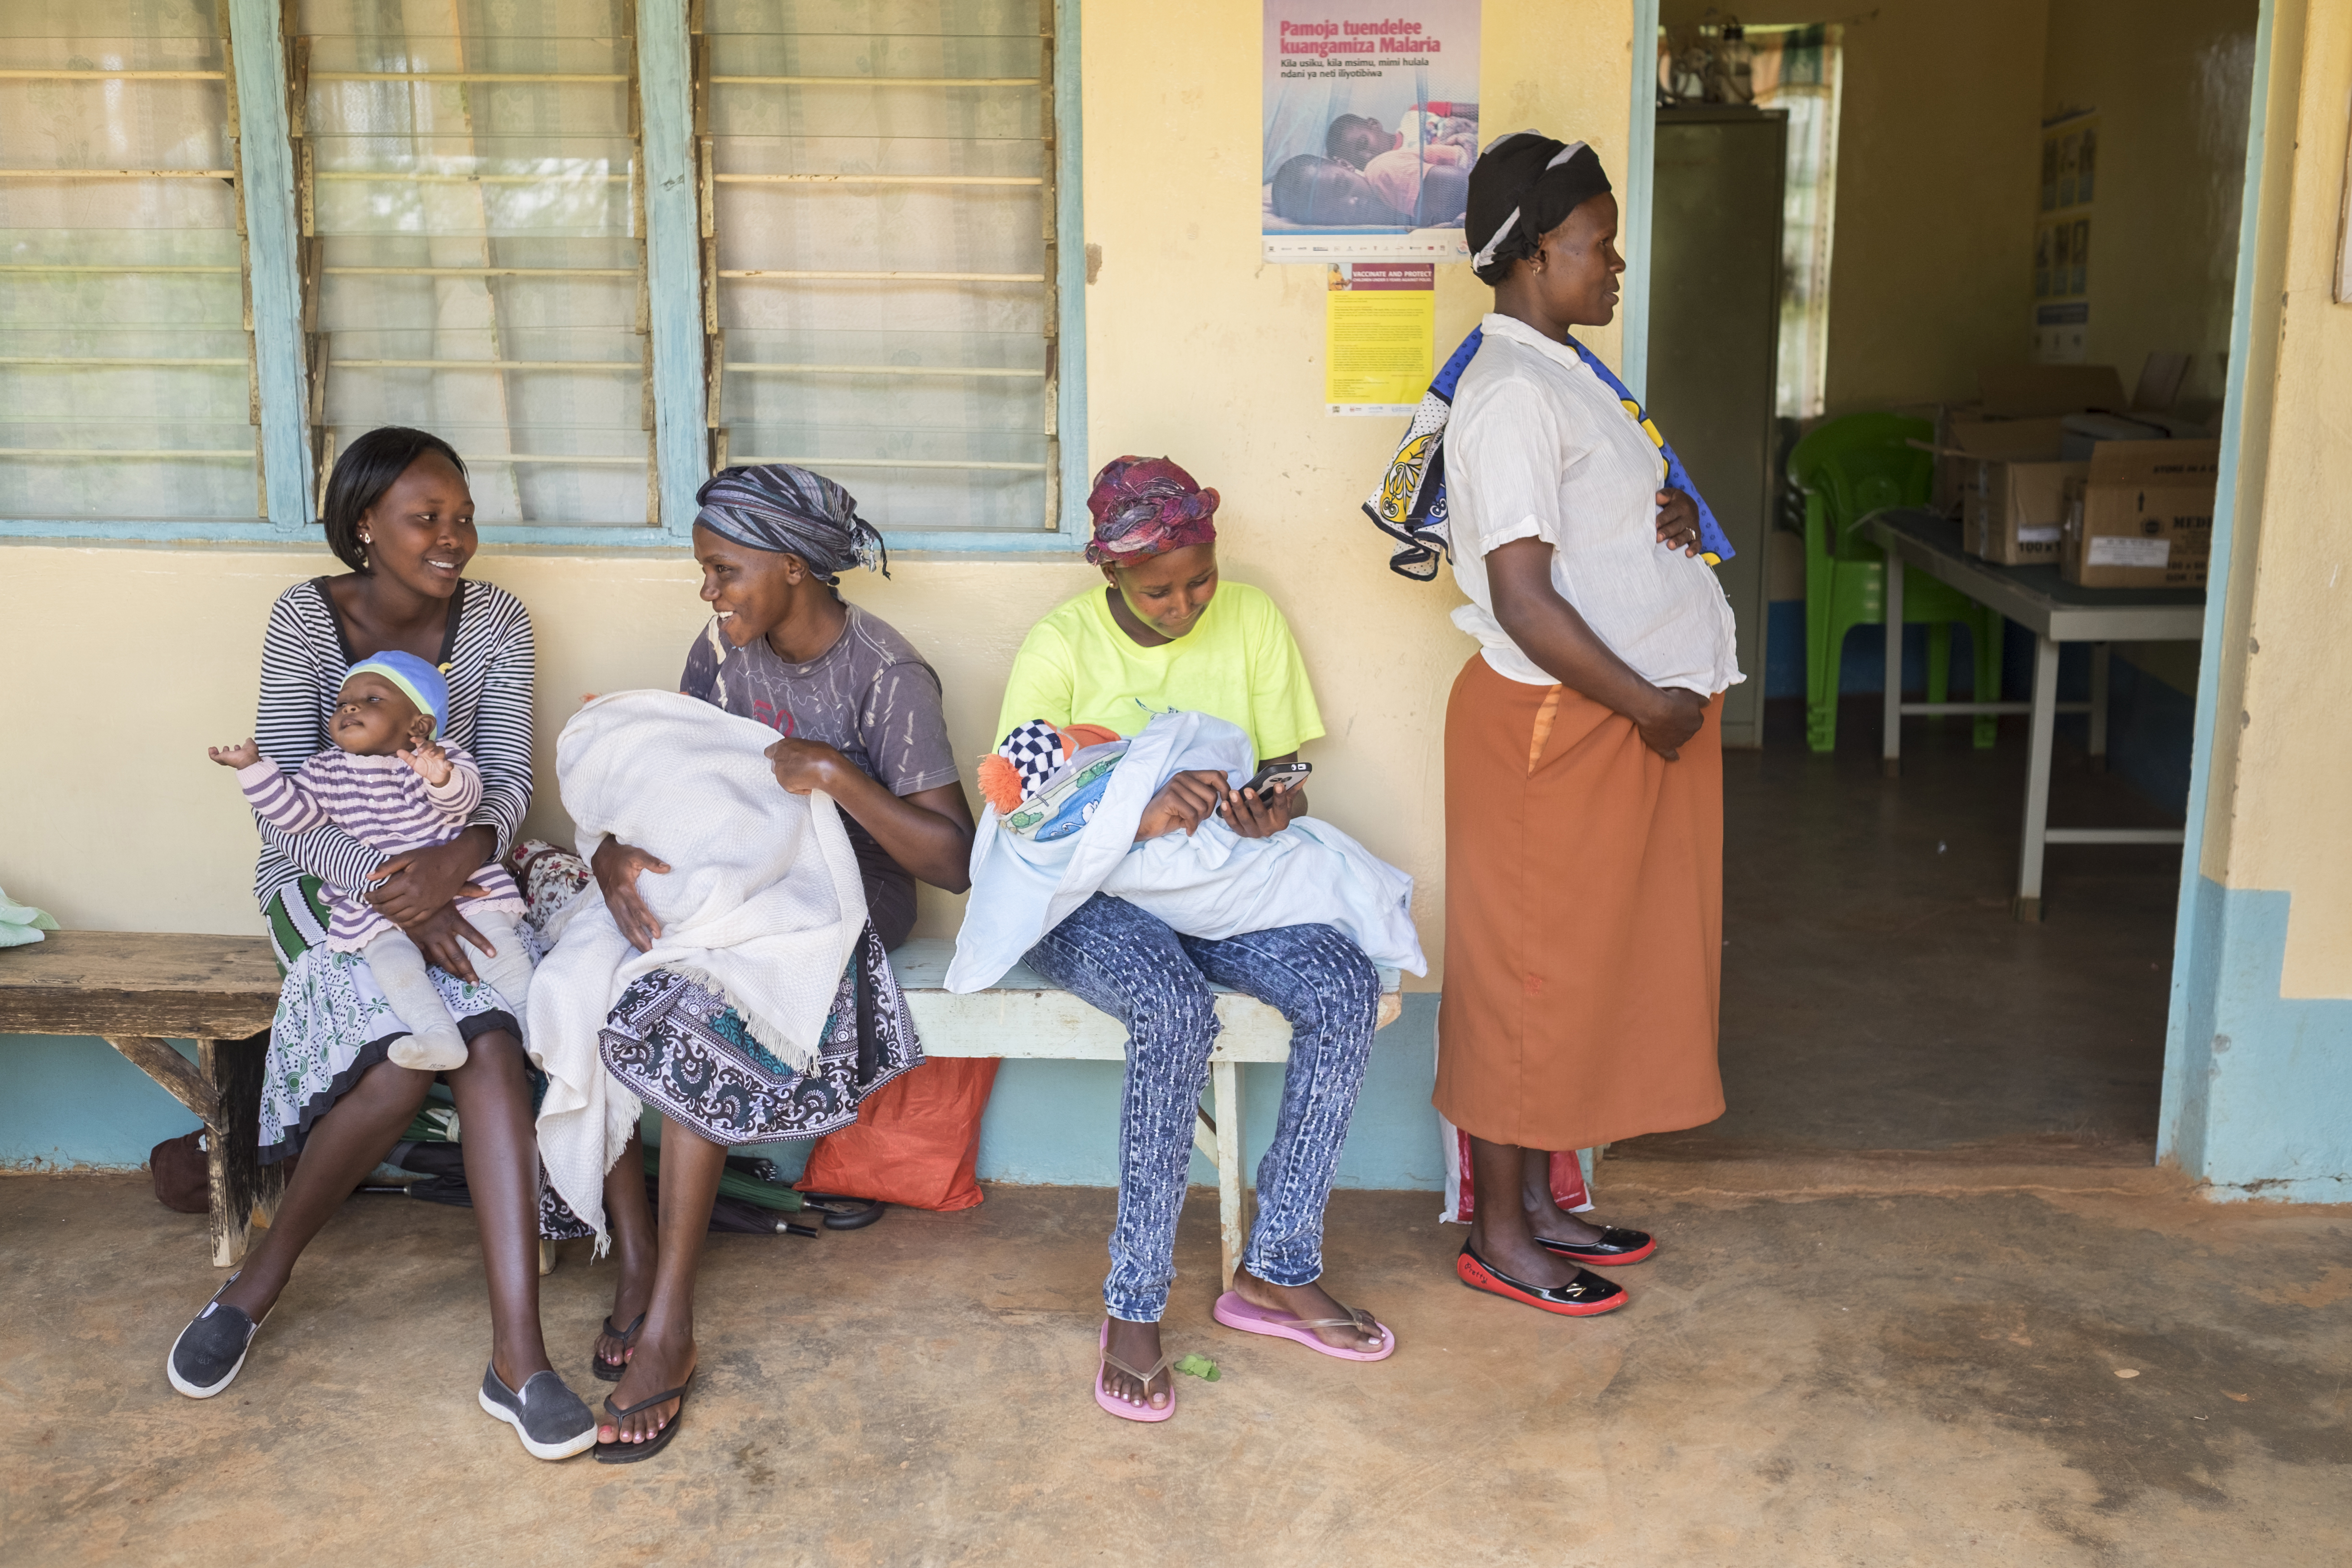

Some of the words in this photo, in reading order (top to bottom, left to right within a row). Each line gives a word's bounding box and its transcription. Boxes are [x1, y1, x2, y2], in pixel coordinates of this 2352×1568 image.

[1280, 19, 1338, 39] Pamoja
[1343, 18, 1422, 35] tuendelee
[1280, 37, 1375, 58] kuangamiza
[1379, 36, 1441, 52] Malaria
[1281, 59, 1297, 67] Kila
[1299, 58, 1324, 68] usiku,
[1327, 58, 1342, 67] kila
[1345, 58, 1375, 68] msimu,
[1379, 58, 1400, 66] mimi
[1403, 57, 1429, 66] hulala
[1281, 69, 1305, 78] ndani
[1307, 71, 1317, 80] ya
[1320, 69, 1336, 77] neti
[1338, 69, 1383, 80] iliyotibiwa
[1464, 1261, 1488, 1285] Pretty
